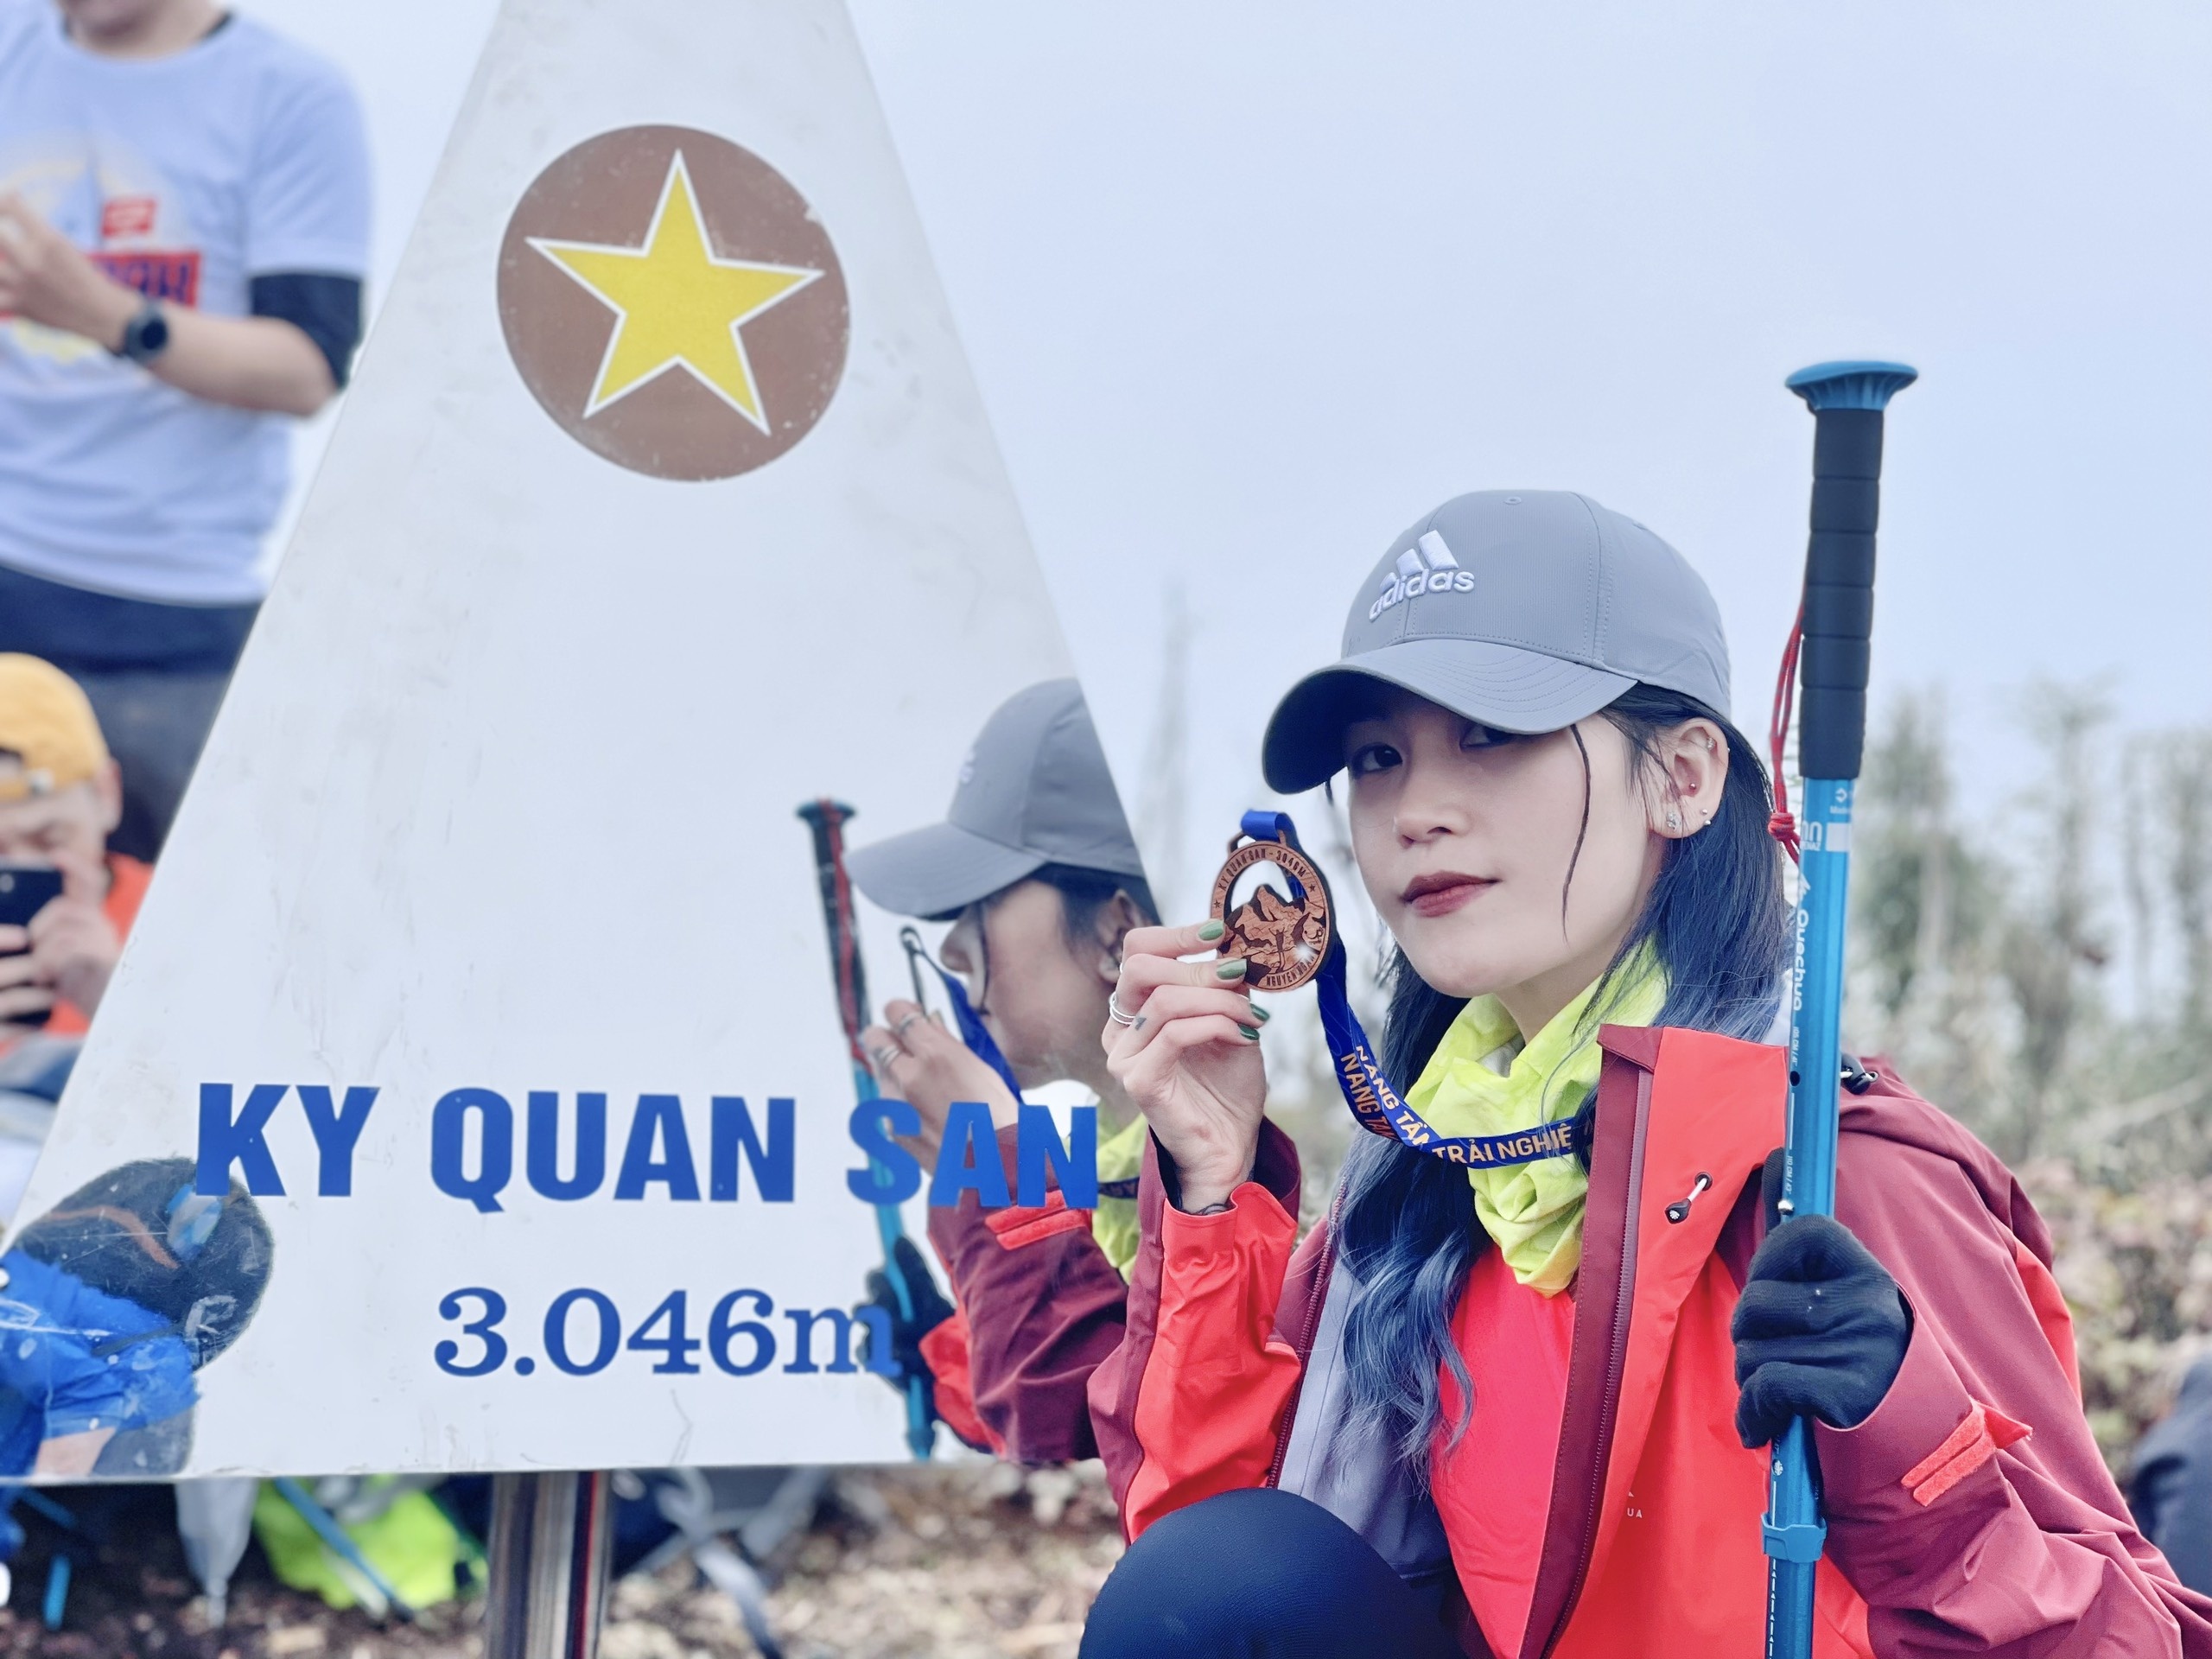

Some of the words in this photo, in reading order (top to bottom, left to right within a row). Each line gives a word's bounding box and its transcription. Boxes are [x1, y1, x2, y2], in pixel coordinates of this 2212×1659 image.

[1369, 569, 1475, 623] adidas
[1225, 855, 1247, 877] QUAN
[1249, 849, 1266, 861] SAN
[194, 1083, 380, 1197] KY
[430, 1087, 795, 1213] QUAN
[847, 1098, 1100, 1210] SAN
[1497, 1123, 1573, 1160] NGHIỆ
[434, 1287, 902, 1378] 3.046m
